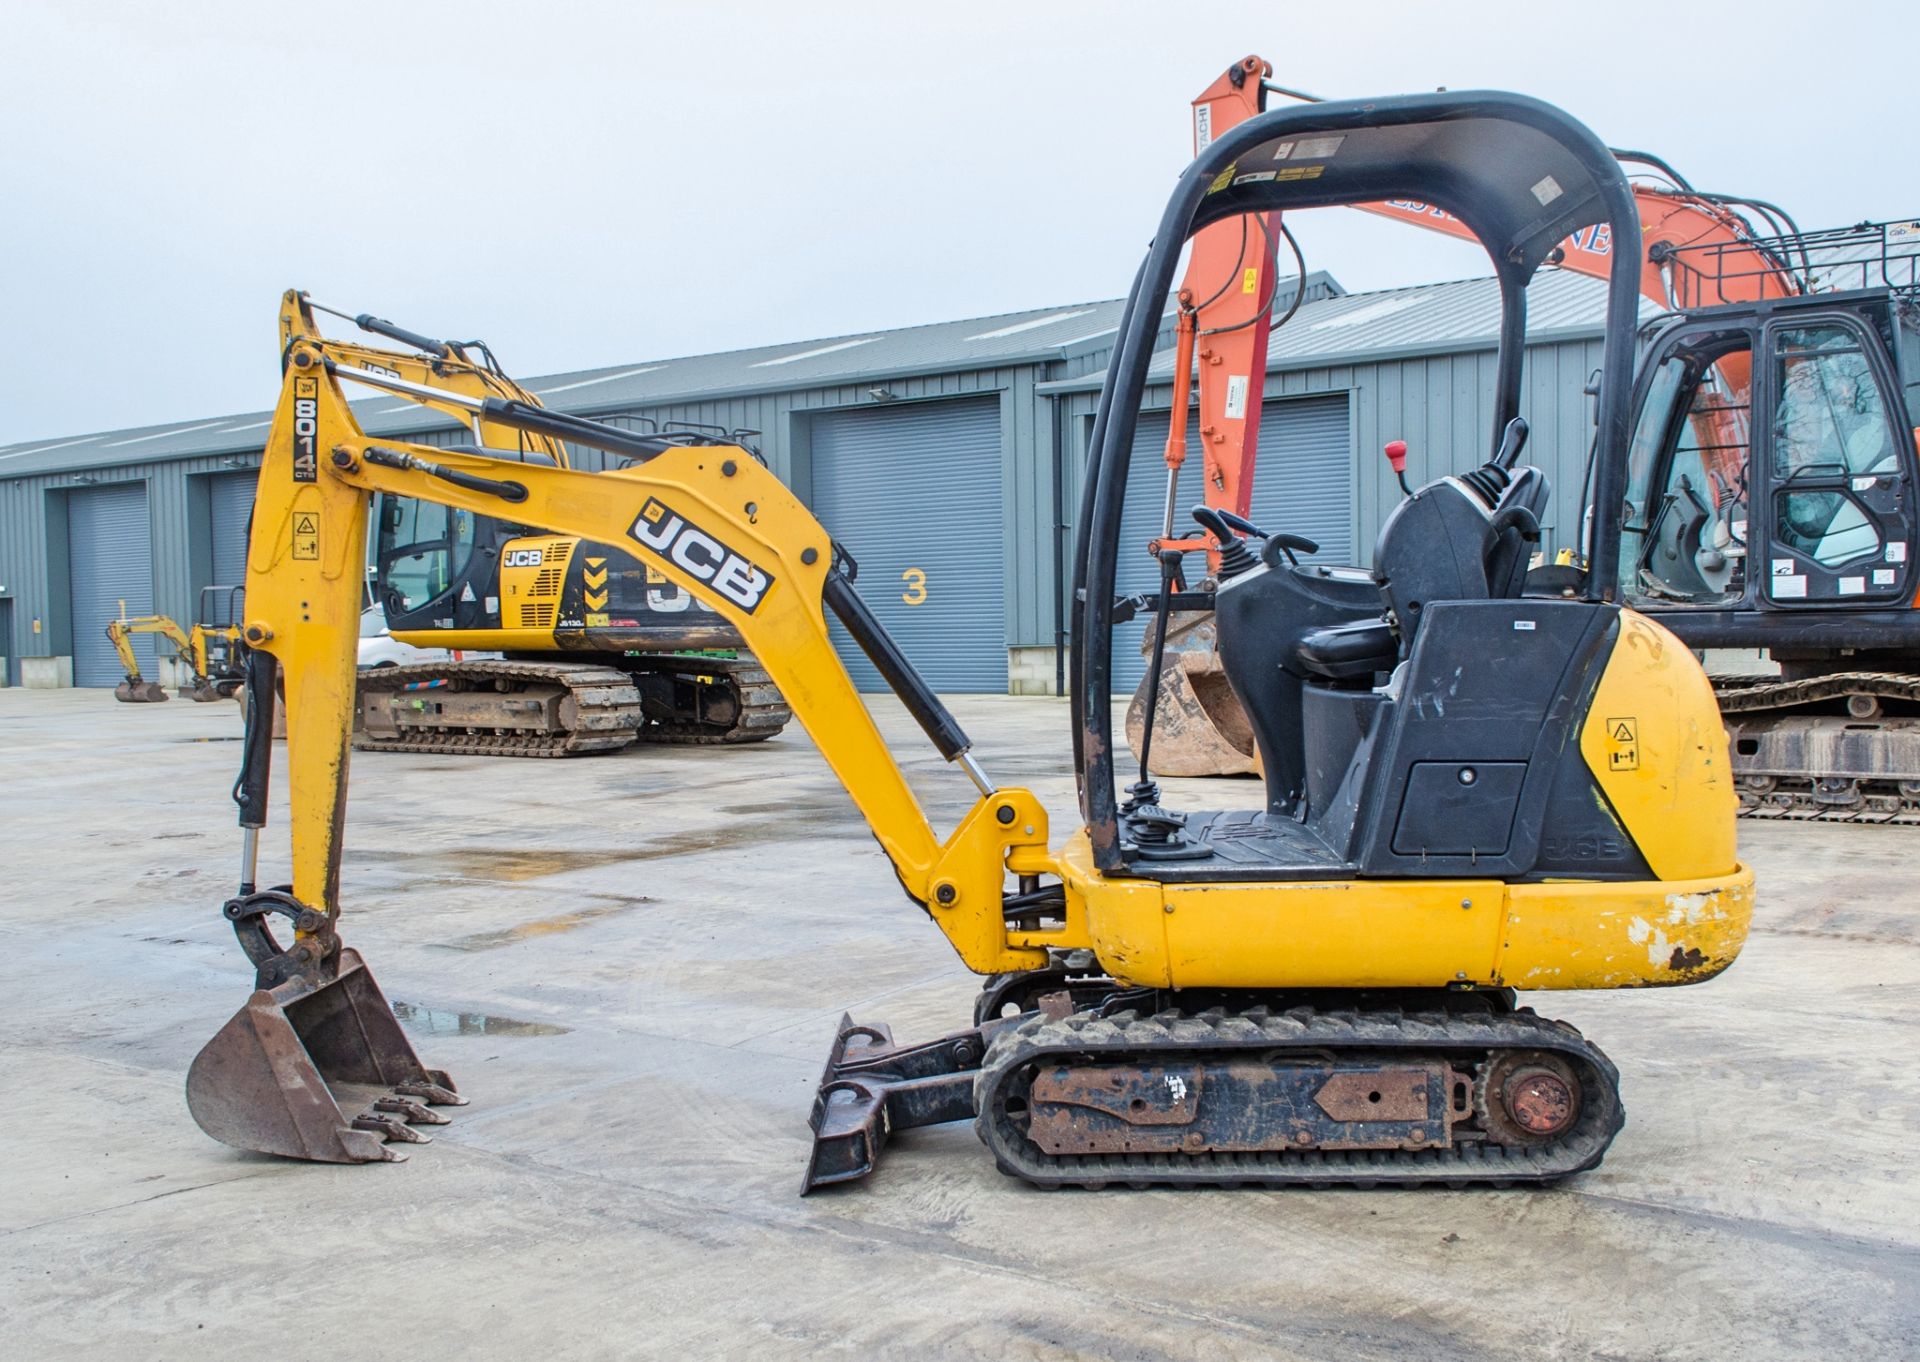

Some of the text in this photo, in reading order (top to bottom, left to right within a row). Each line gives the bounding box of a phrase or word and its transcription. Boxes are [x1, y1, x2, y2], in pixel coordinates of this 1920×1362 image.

[295, 400, 316, 472] 8014
[504, 551, 542, 567] JCB
[633, 514, 767, 608] JCB
[902, 567, 928, 606] 3
